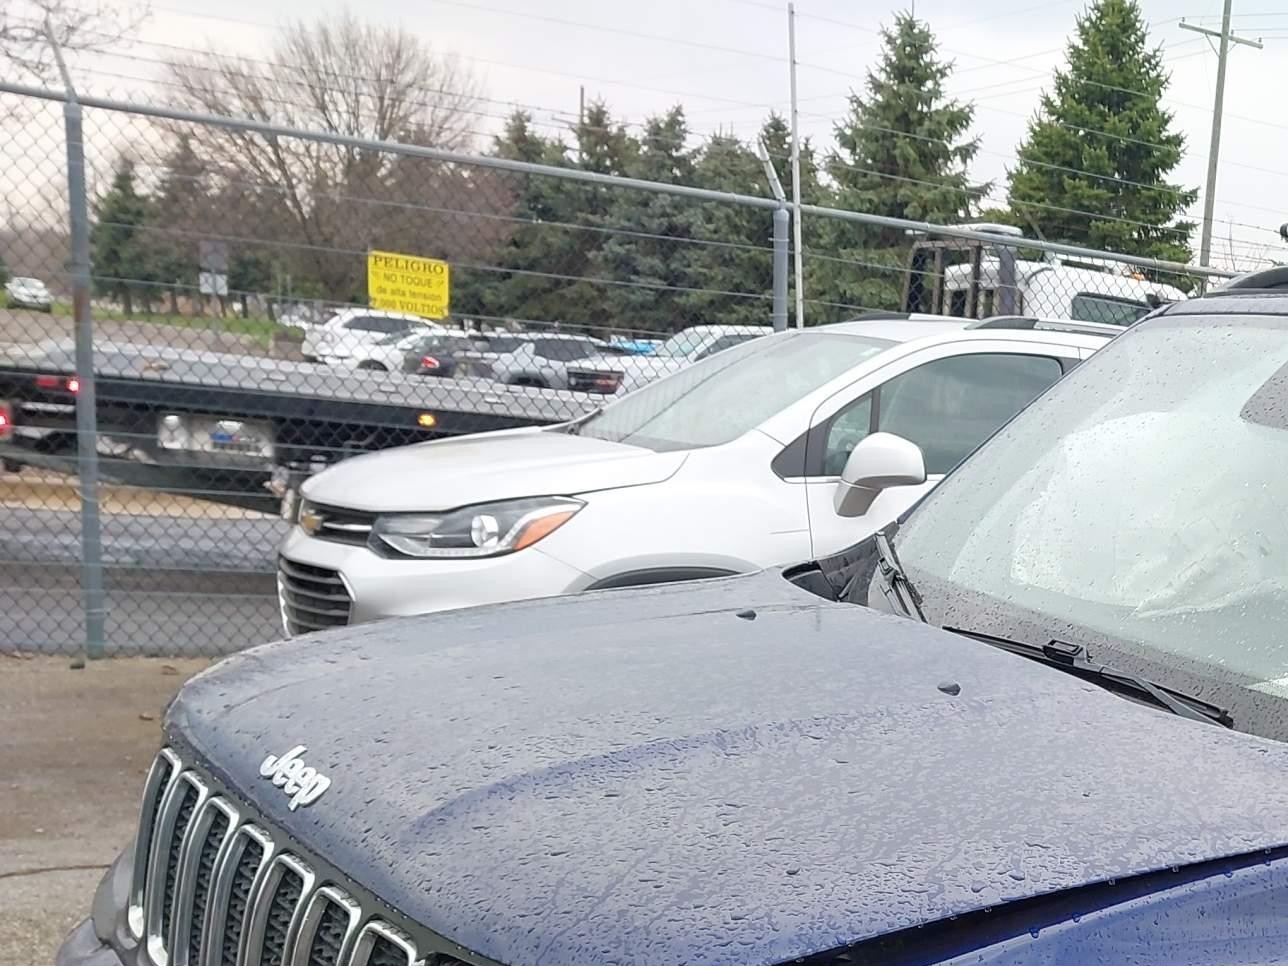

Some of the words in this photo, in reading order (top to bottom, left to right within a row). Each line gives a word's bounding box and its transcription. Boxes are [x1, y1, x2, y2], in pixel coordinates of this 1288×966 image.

[373, 255, 444, 274] PELIGRO
[383, 273, 398, 283] NO
[401, 275, 433, 288] TOQUE
[399, 300, 444, 316] VOLTIOS
[260, 744, 332, 811] Jeep
